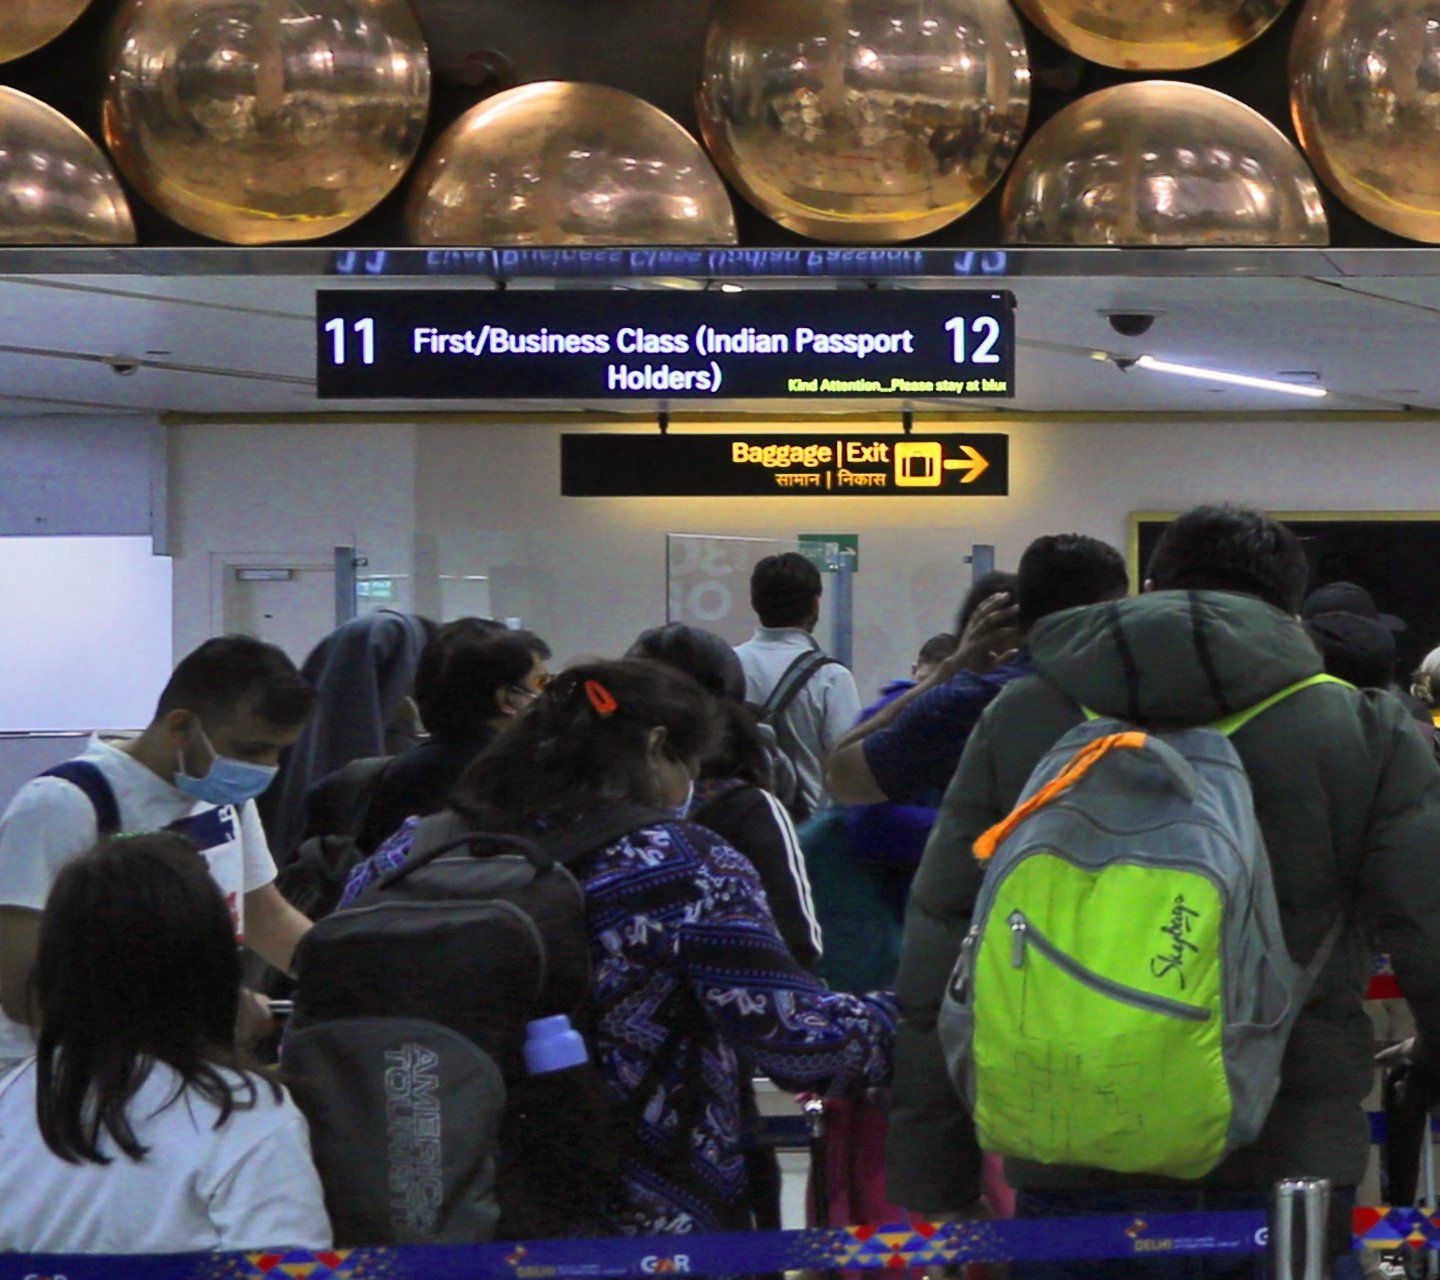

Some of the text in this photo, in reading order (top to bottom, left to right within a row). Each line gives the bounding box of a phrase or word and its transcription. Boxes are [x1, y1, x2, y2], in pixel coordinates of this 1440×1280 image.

[325, 318, 374, 364] 11
[413, 324, 913, 358] First/Business Class (Indian Passport
[944, 316, 1000, 364] 12
[607, 361, 722, 392] Holders)
[788, 379, 817, 392] Kind
[935, 381, 963, 394] stay
[966, 380, 980, 392] at
[732, 442, 888, 468] Baggage Exit
[775, 471, 886, 488] सामान निकास
